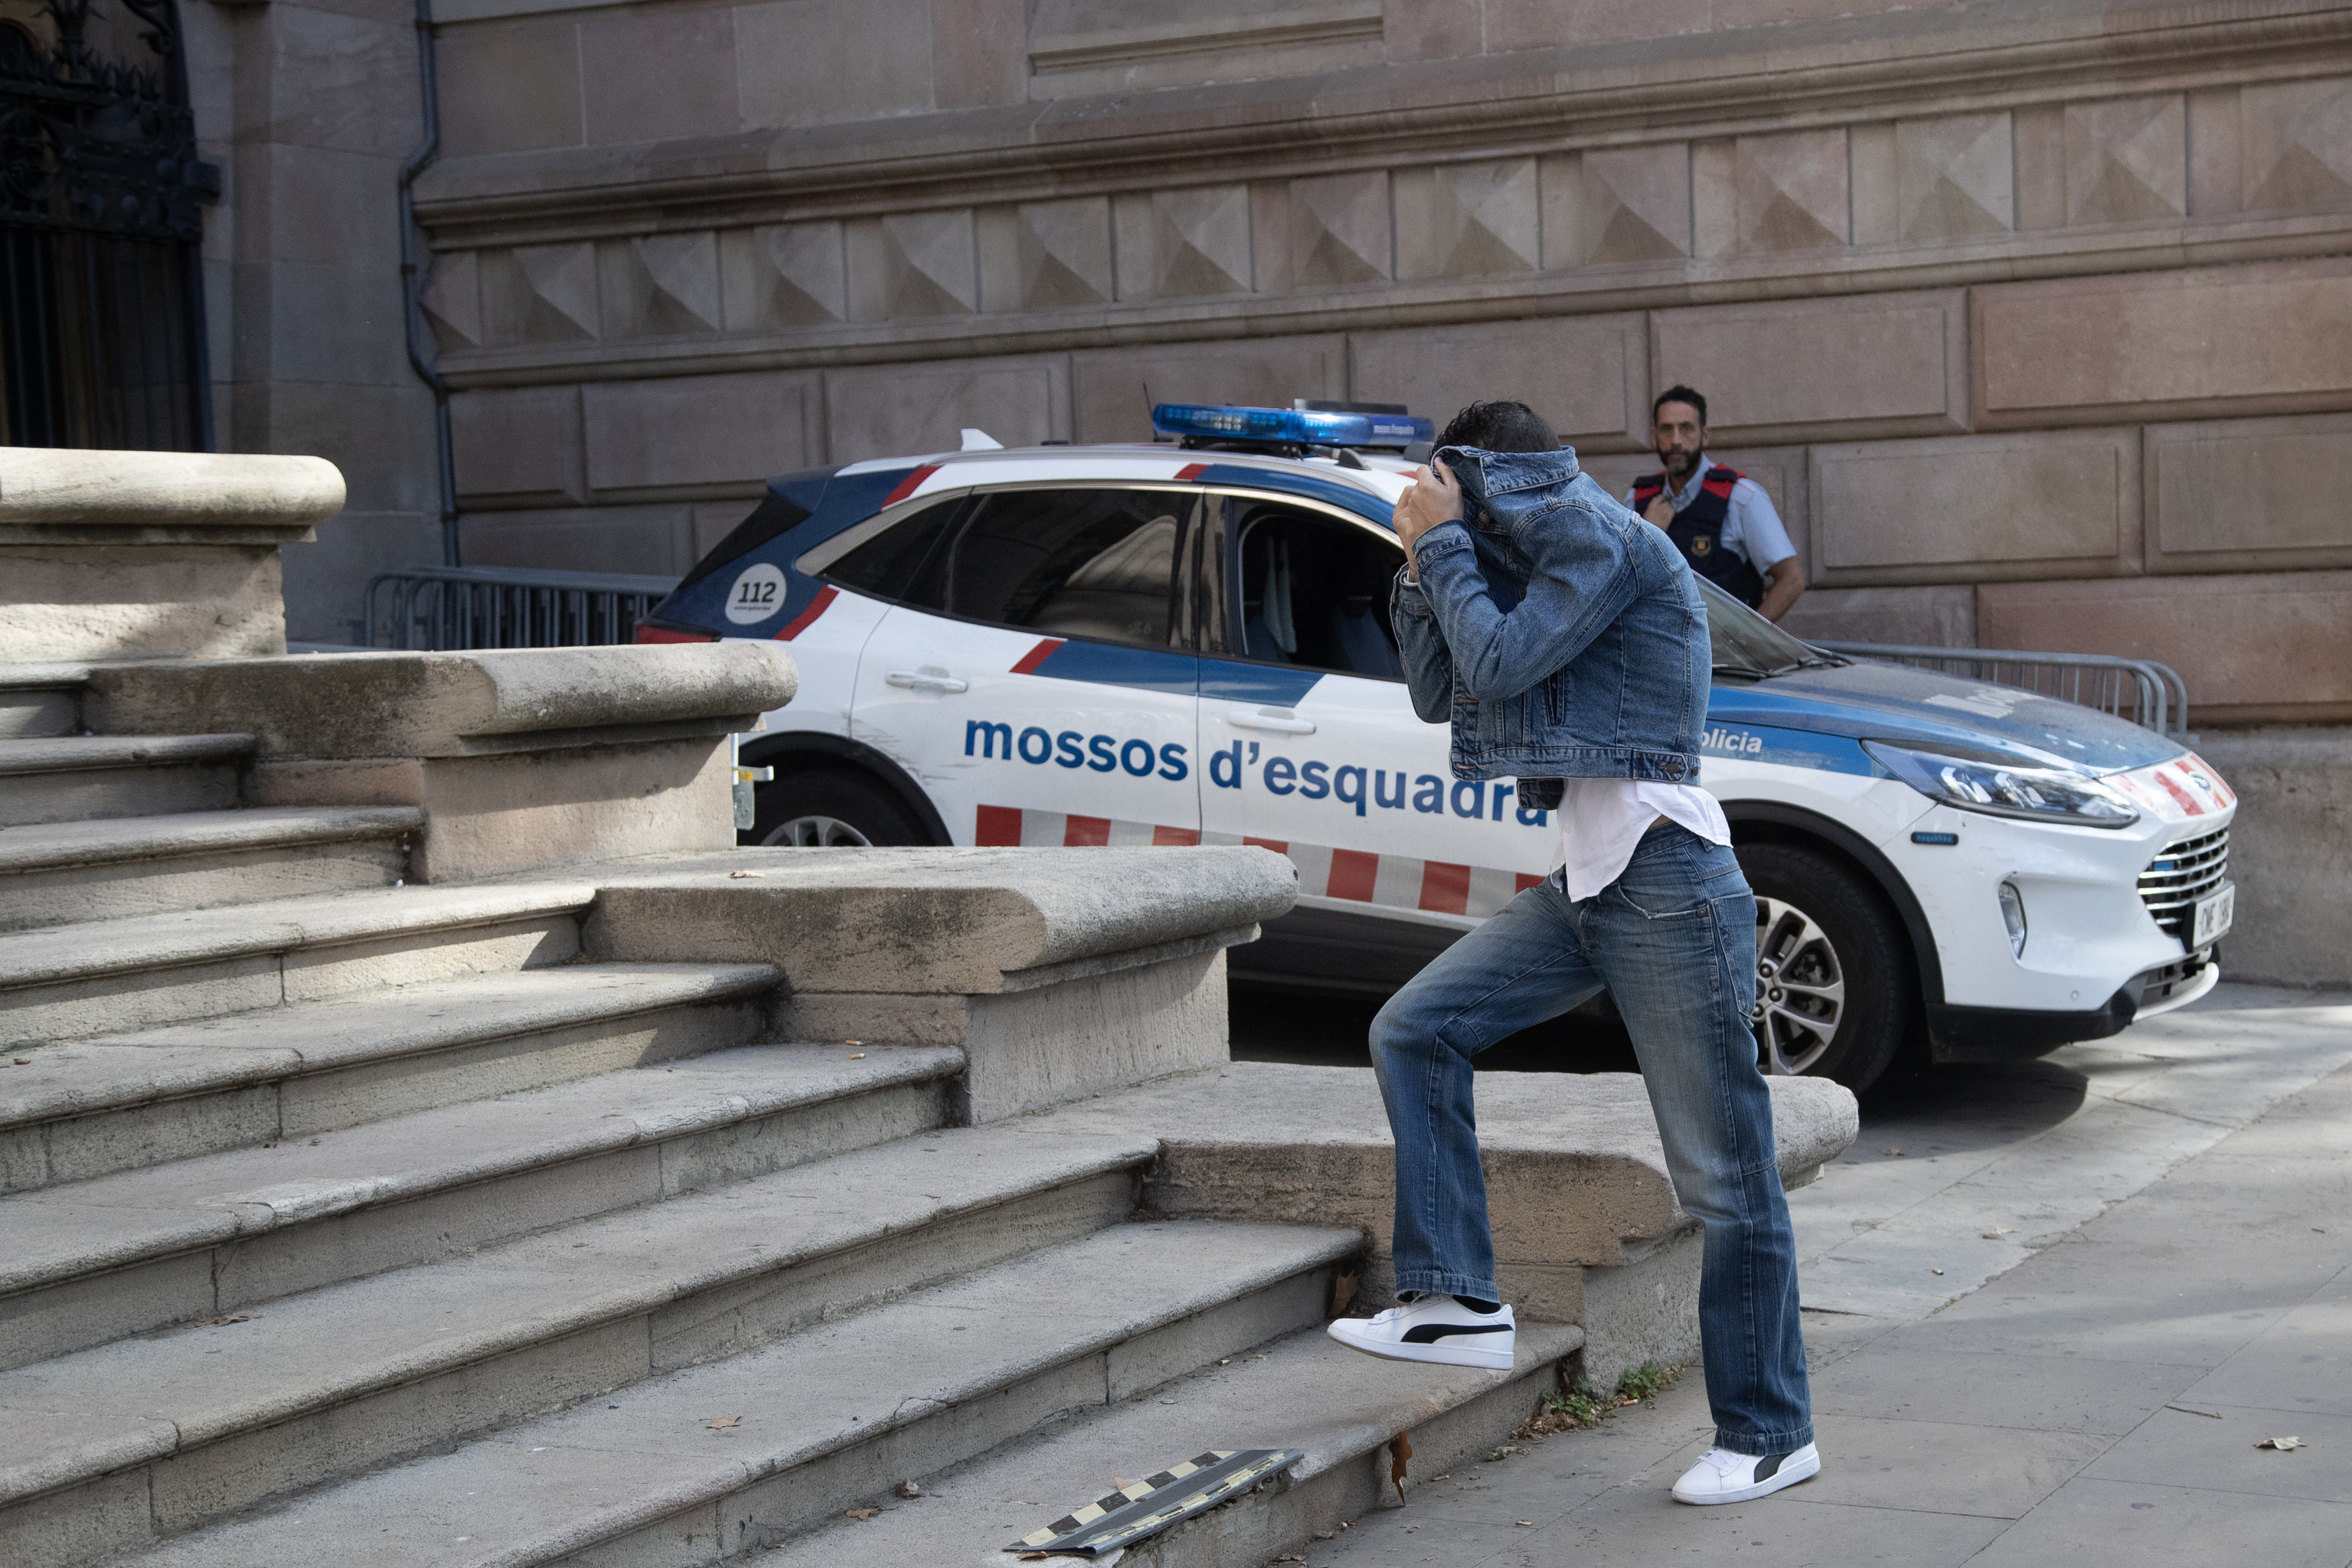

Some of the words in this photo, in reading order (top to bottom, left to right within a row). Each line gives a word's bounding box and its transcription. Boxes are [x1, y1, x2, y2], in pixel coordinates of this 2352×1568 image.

[738, 581, 776, 603] 112
[964, 719, 1188, 782] mossos
[1701, 728, 1762, 753] olicia
